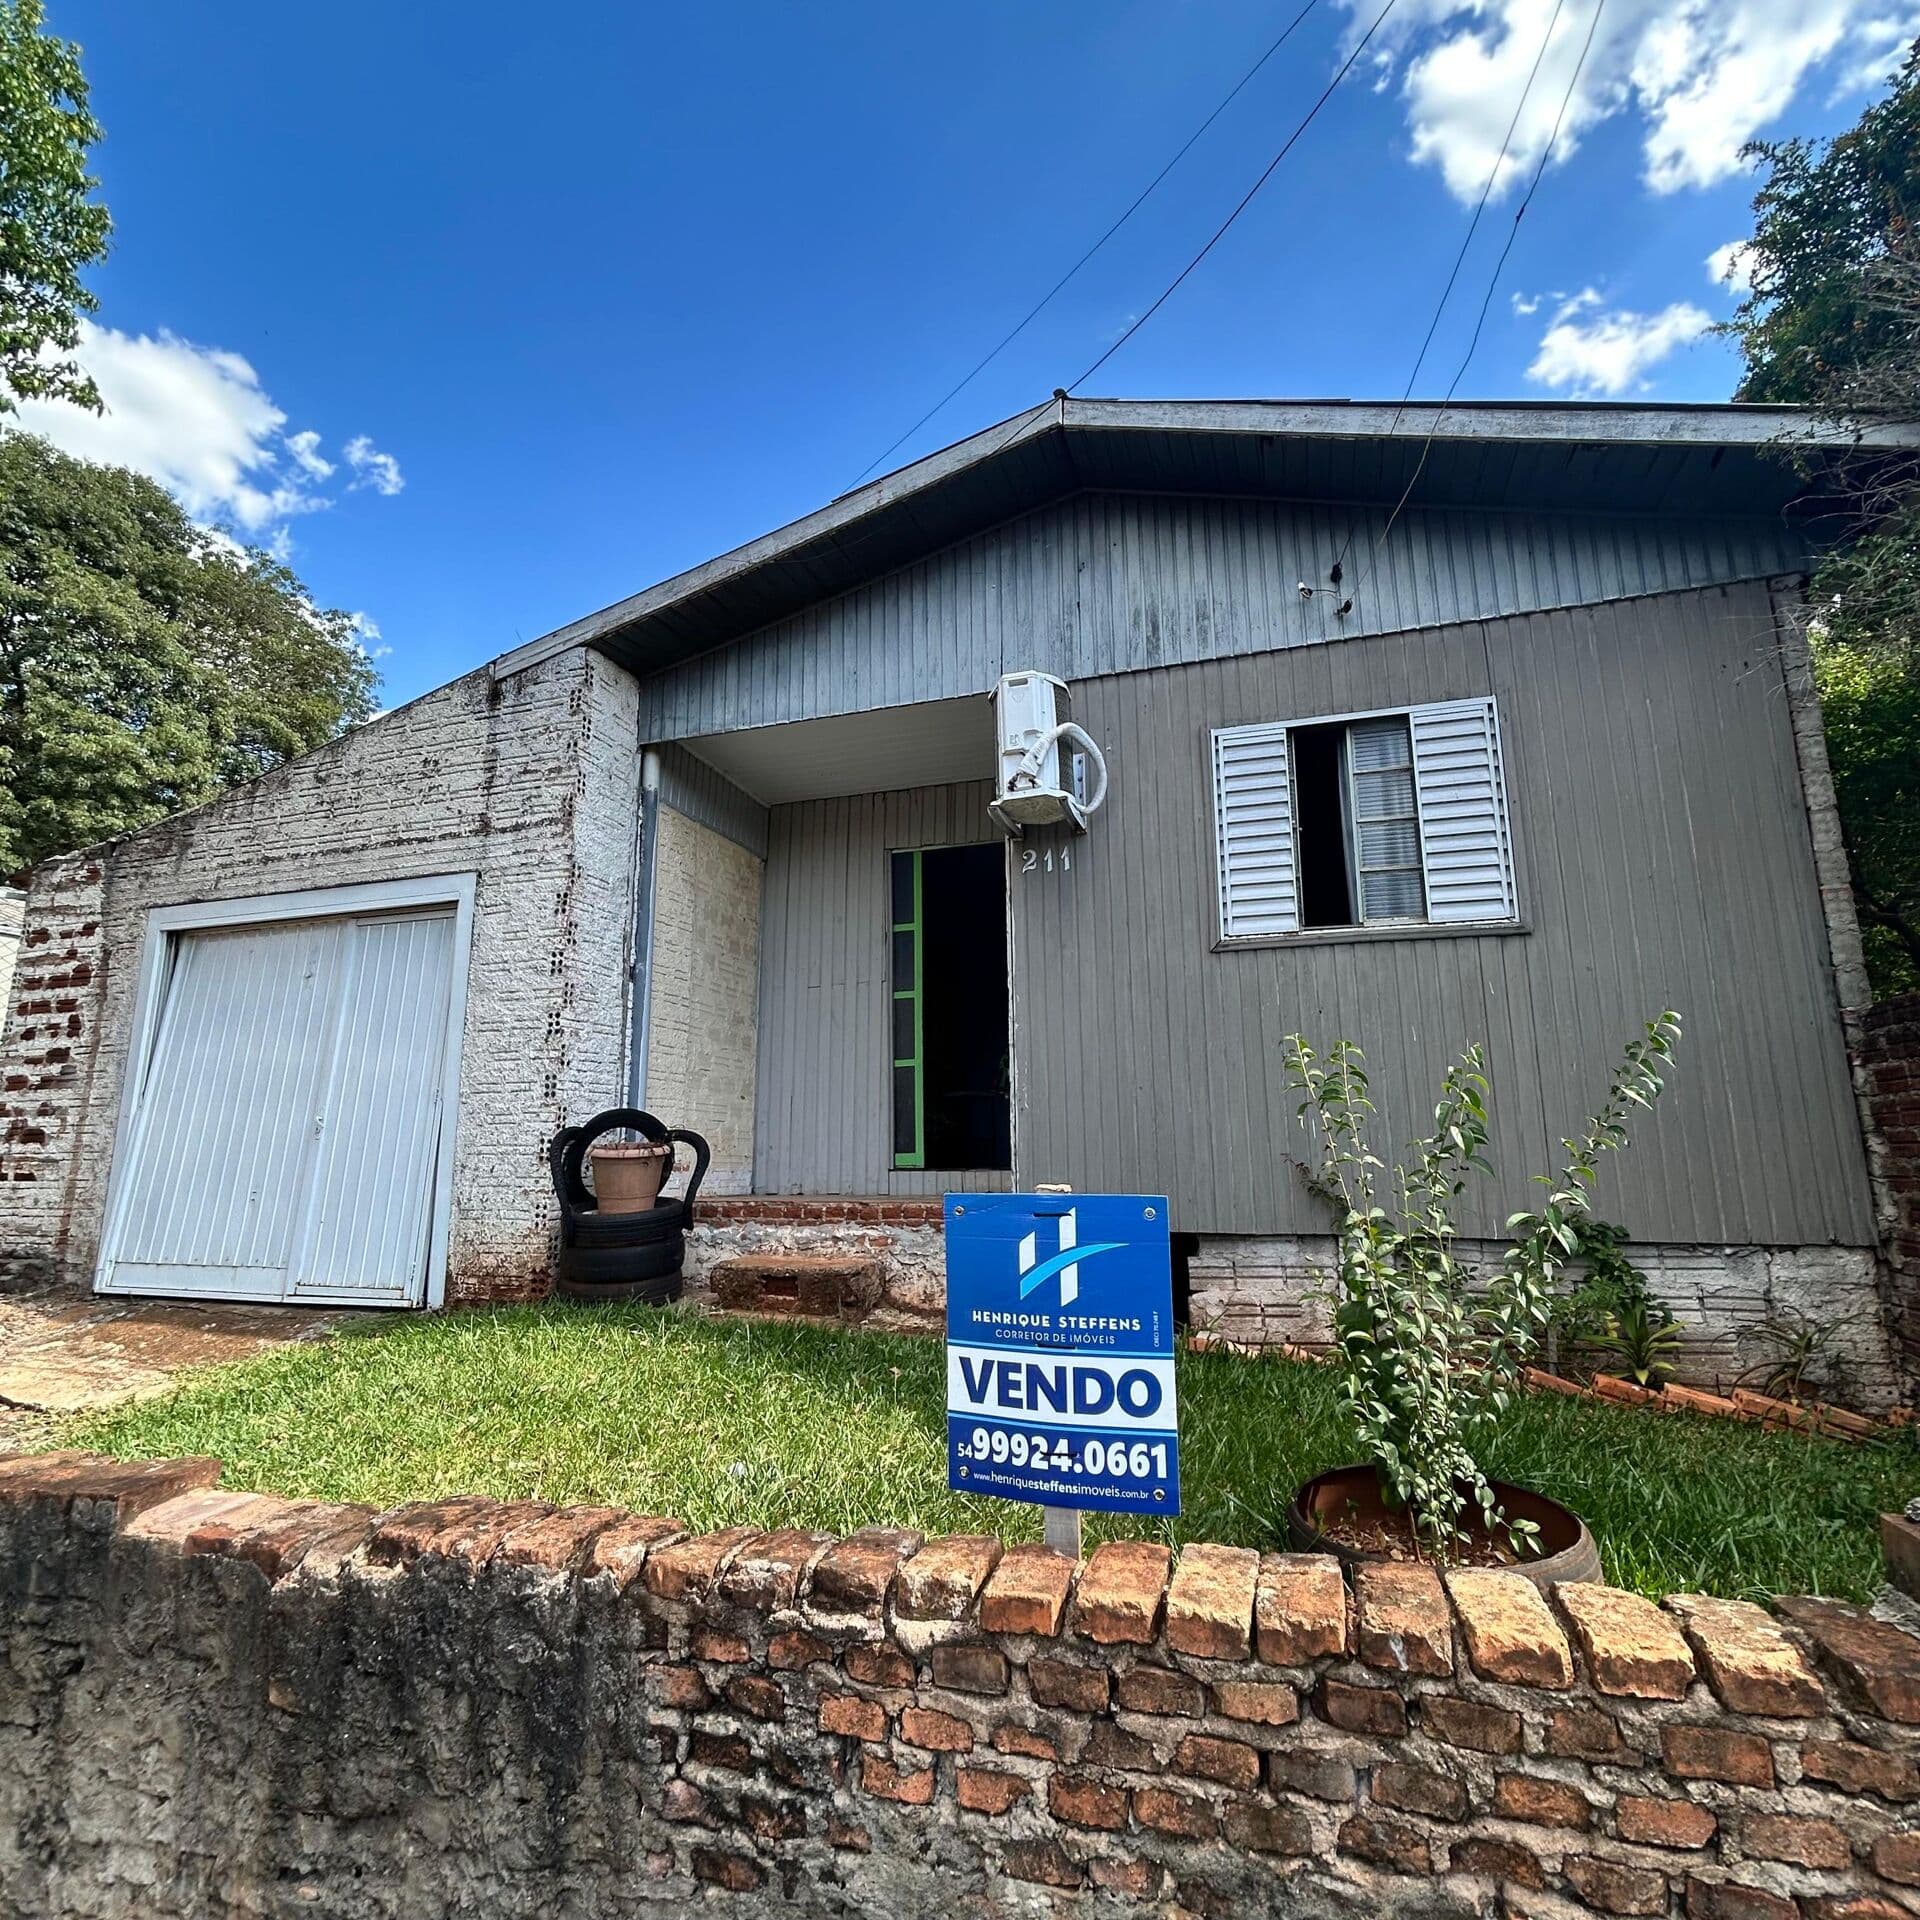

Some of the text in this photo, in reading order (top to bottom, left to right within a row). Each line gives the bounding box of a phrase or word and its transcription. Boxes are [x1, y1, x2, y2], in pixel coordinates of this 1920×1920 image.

[1022, 846, 1071, 873] 211
[972, 1310, 1141, 1331] HENRIQUE STEFFENS
[995, 1329, 1115, 1345] CORRETOR DE IMÓVEIS
[959, 1356, 1163, 1418] VENDO
[972, 1427, 1168, 1479] 99924.0661
[973, 1471, 1149, 1499] www.henriquesteffensimoveis.com.br
